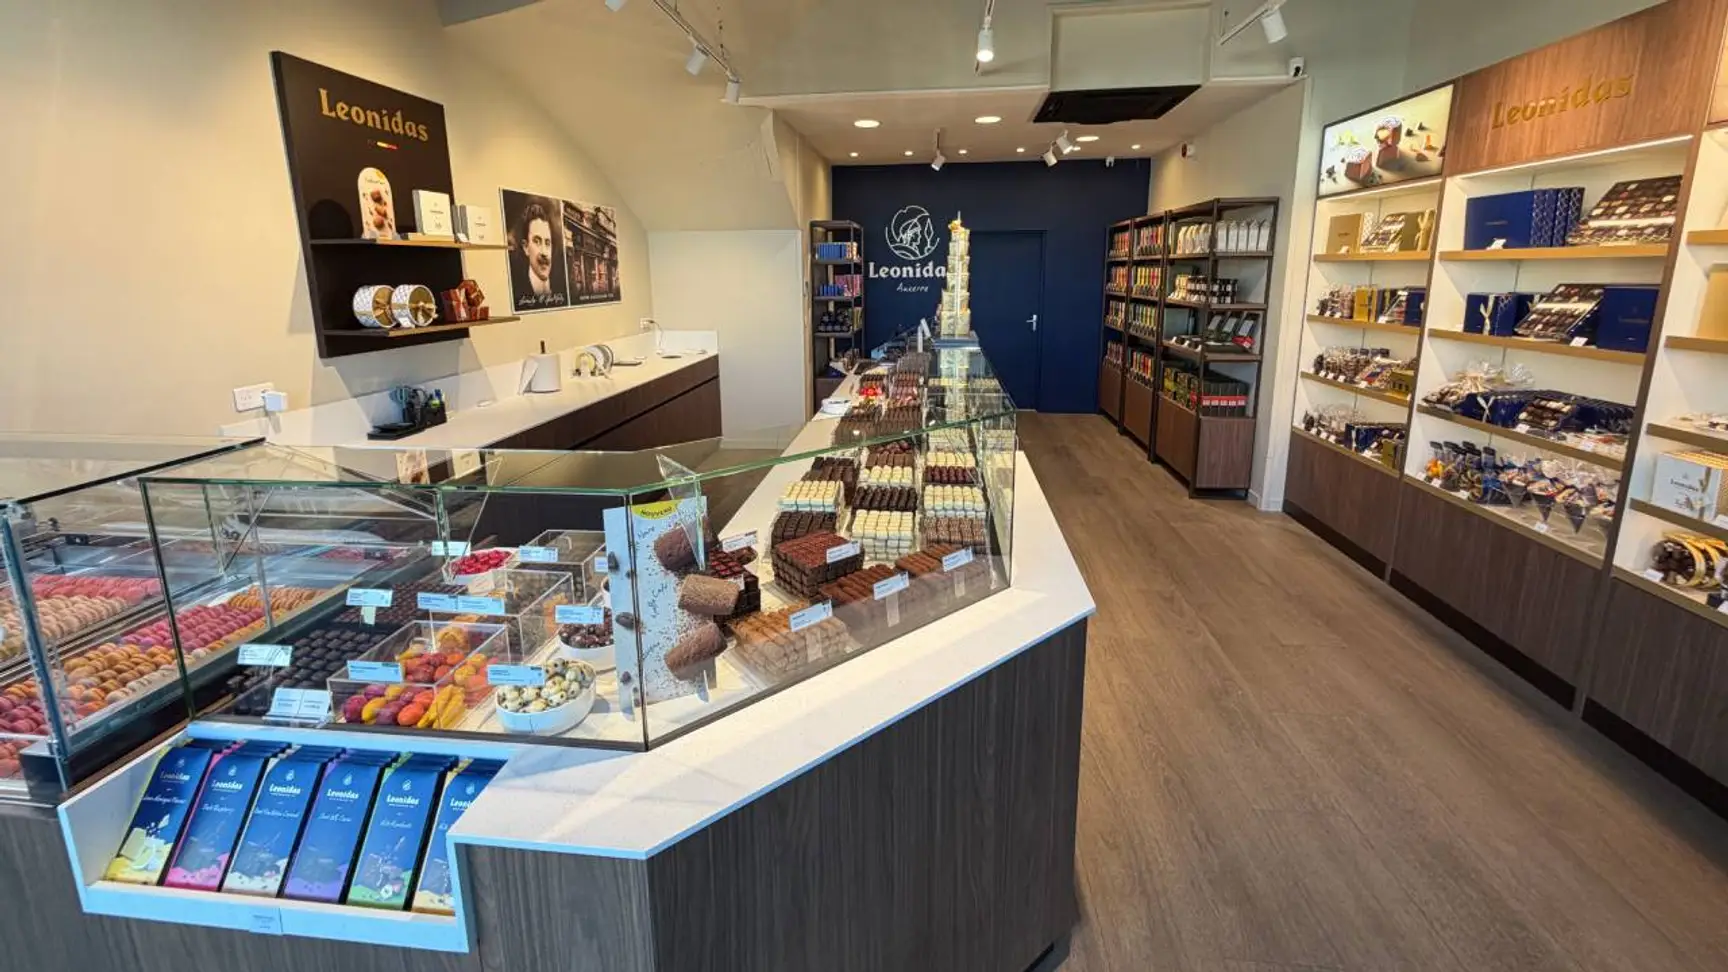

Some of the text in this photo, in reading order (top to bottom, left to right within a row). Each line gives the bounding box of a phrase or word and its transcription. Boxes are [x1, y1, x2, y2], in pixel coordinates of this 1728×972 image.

[1491, 73, 1634, 130] Leonidas
[318, 87, 429, 142] Leonidas
[868, 261, 948, 279] Leonida
[896, 281, 929, 293] Auxerre
[269, 783, 301, 795] Leonidas
[326, 788, 359, 800] Leonidas
[386, 794, 420, 805] Leonidas
